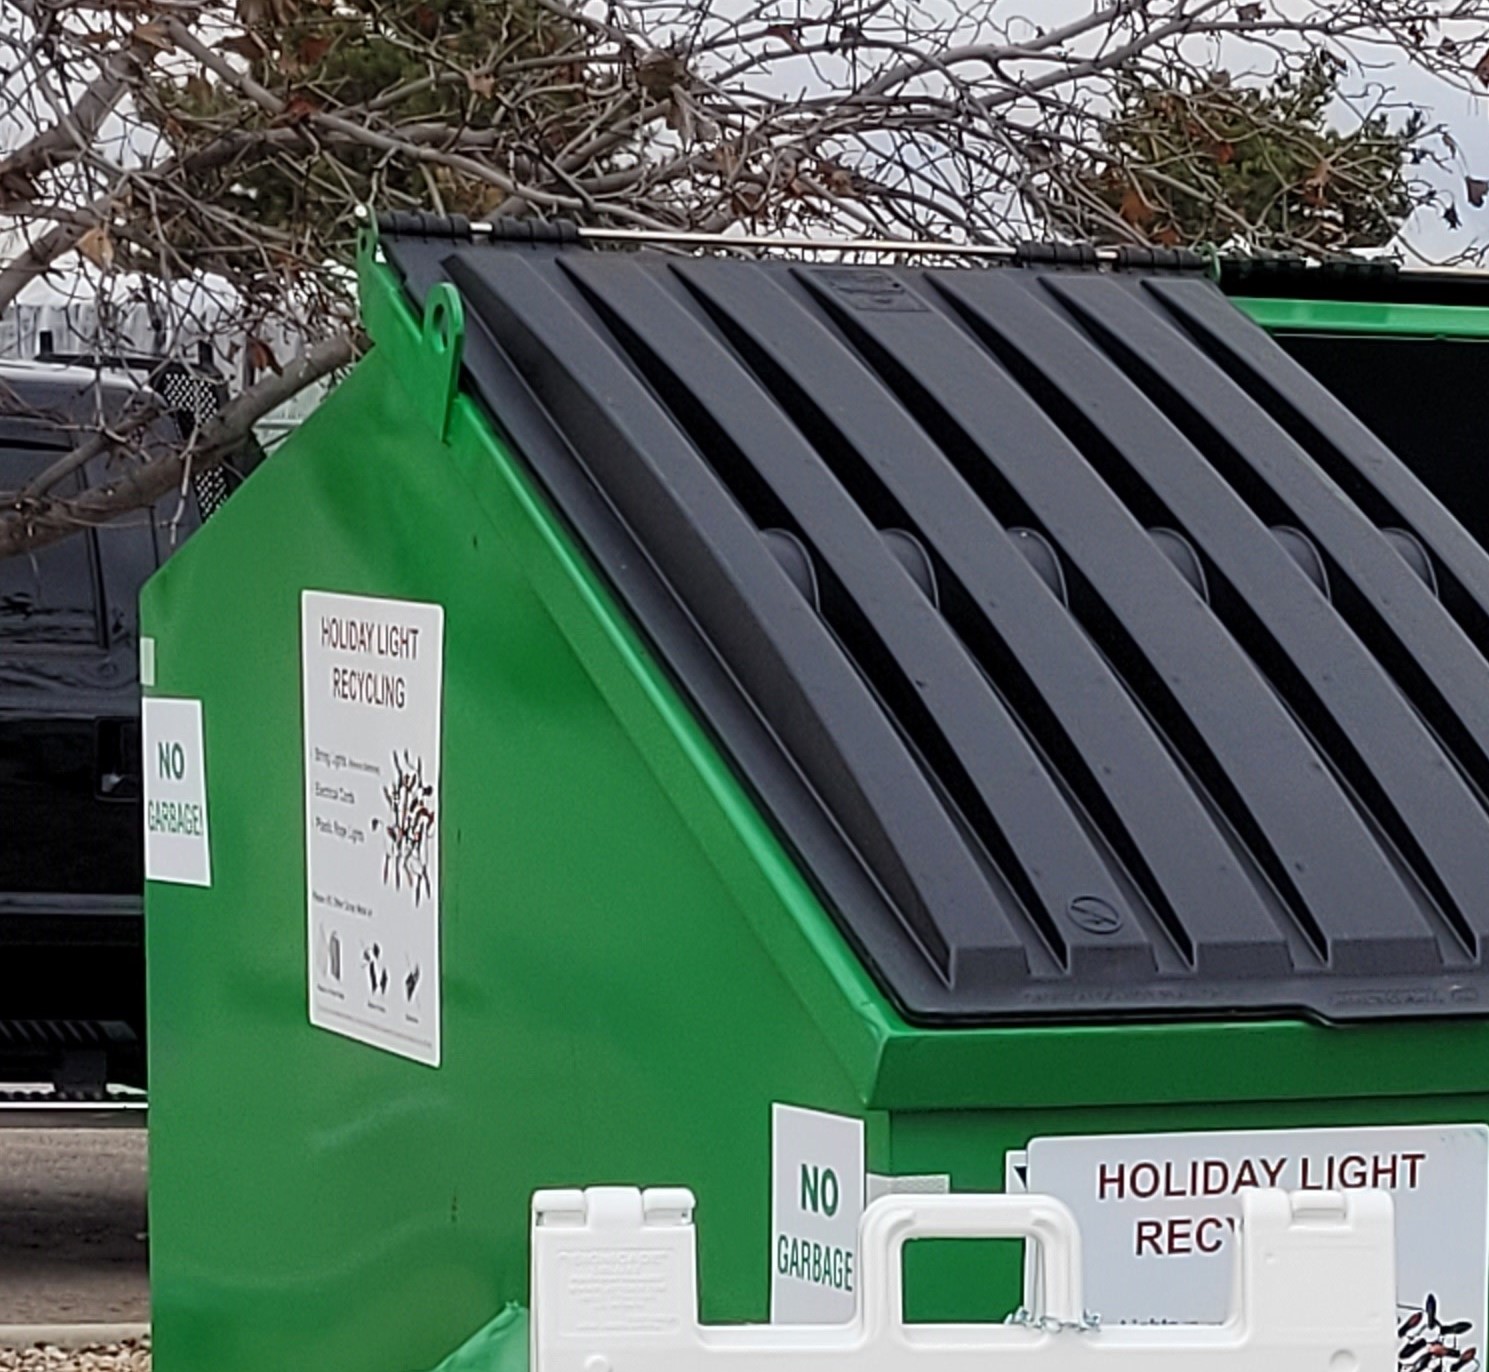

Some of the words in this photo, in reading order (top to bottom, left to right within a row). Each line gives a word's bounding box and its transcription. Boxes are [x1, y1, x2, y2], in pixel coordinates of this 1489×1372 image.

[321, 616, 373, 657] HOLIDAY
[376, 624, 419, 661] LIGHT
[333, 667, 405, 709] RECYCLING
[157, 740, 185, 781] NO
[801, 1163, 839, 1218] NO
[1098, 1157, 1287, 1200] HOLIDAY
[1300, 1153, 1426, 1194] LIGHT
